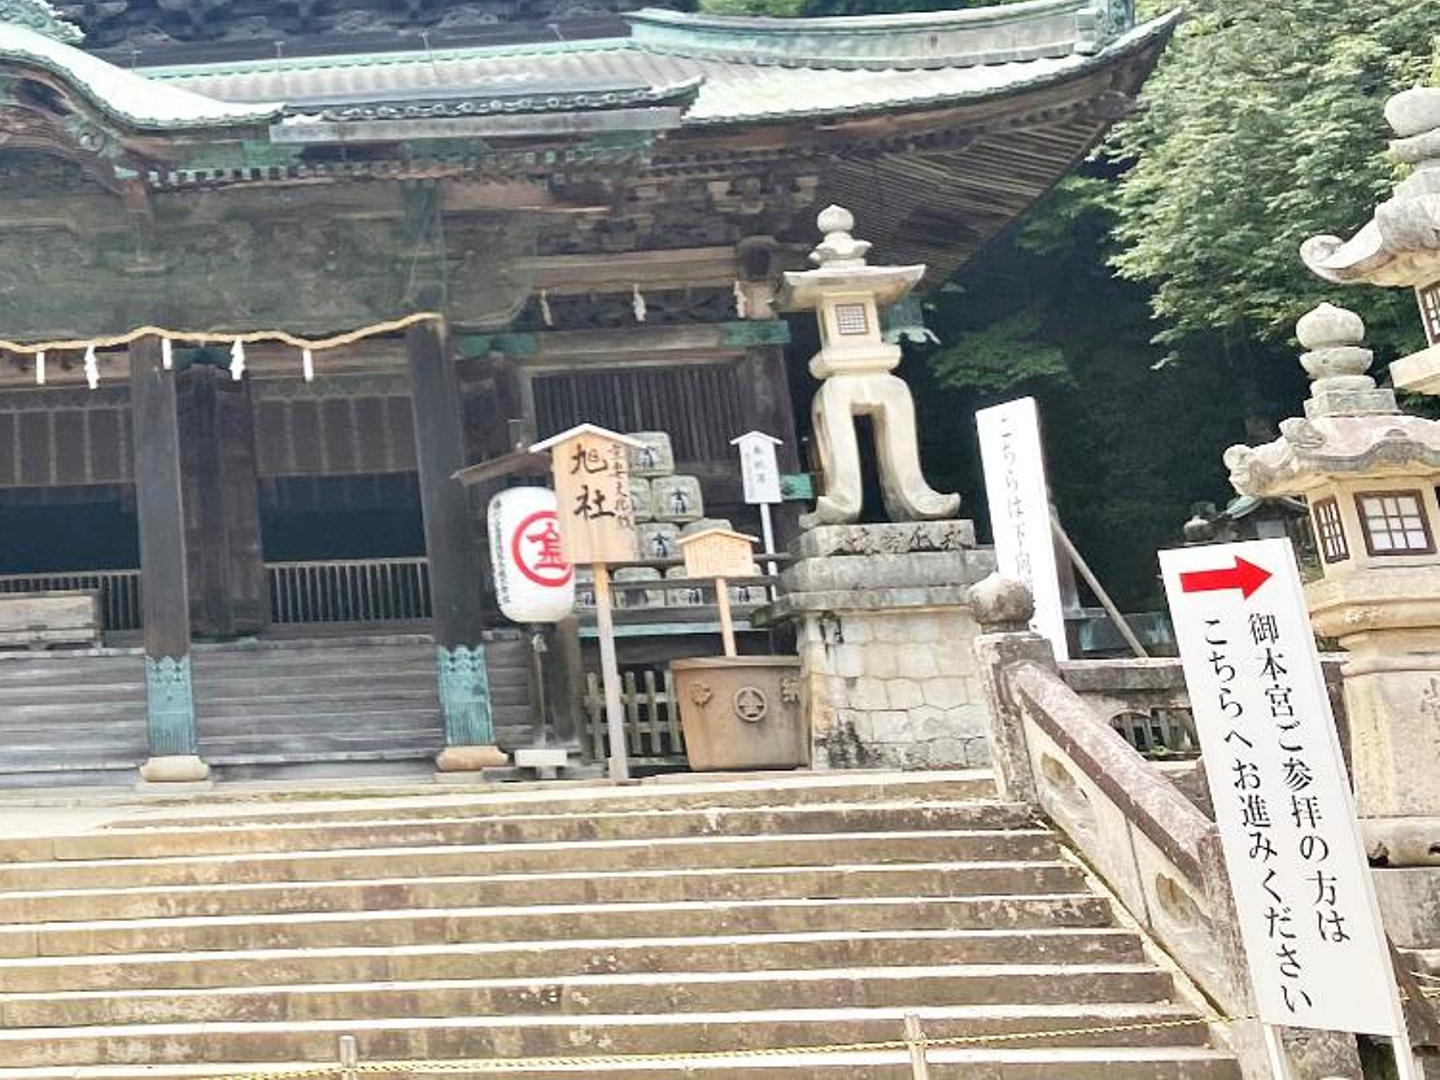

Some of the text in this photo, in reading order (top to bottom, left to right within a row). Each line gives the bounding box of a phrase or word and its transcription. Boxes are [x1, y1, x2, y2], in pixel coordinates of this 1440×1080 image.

[570, 443, 616, 521] 旭社
[1202, 619, 1313, 1014] こちらへお進みください
[1247, 612, 1351, 944] 御本宮ご参拝の方は
